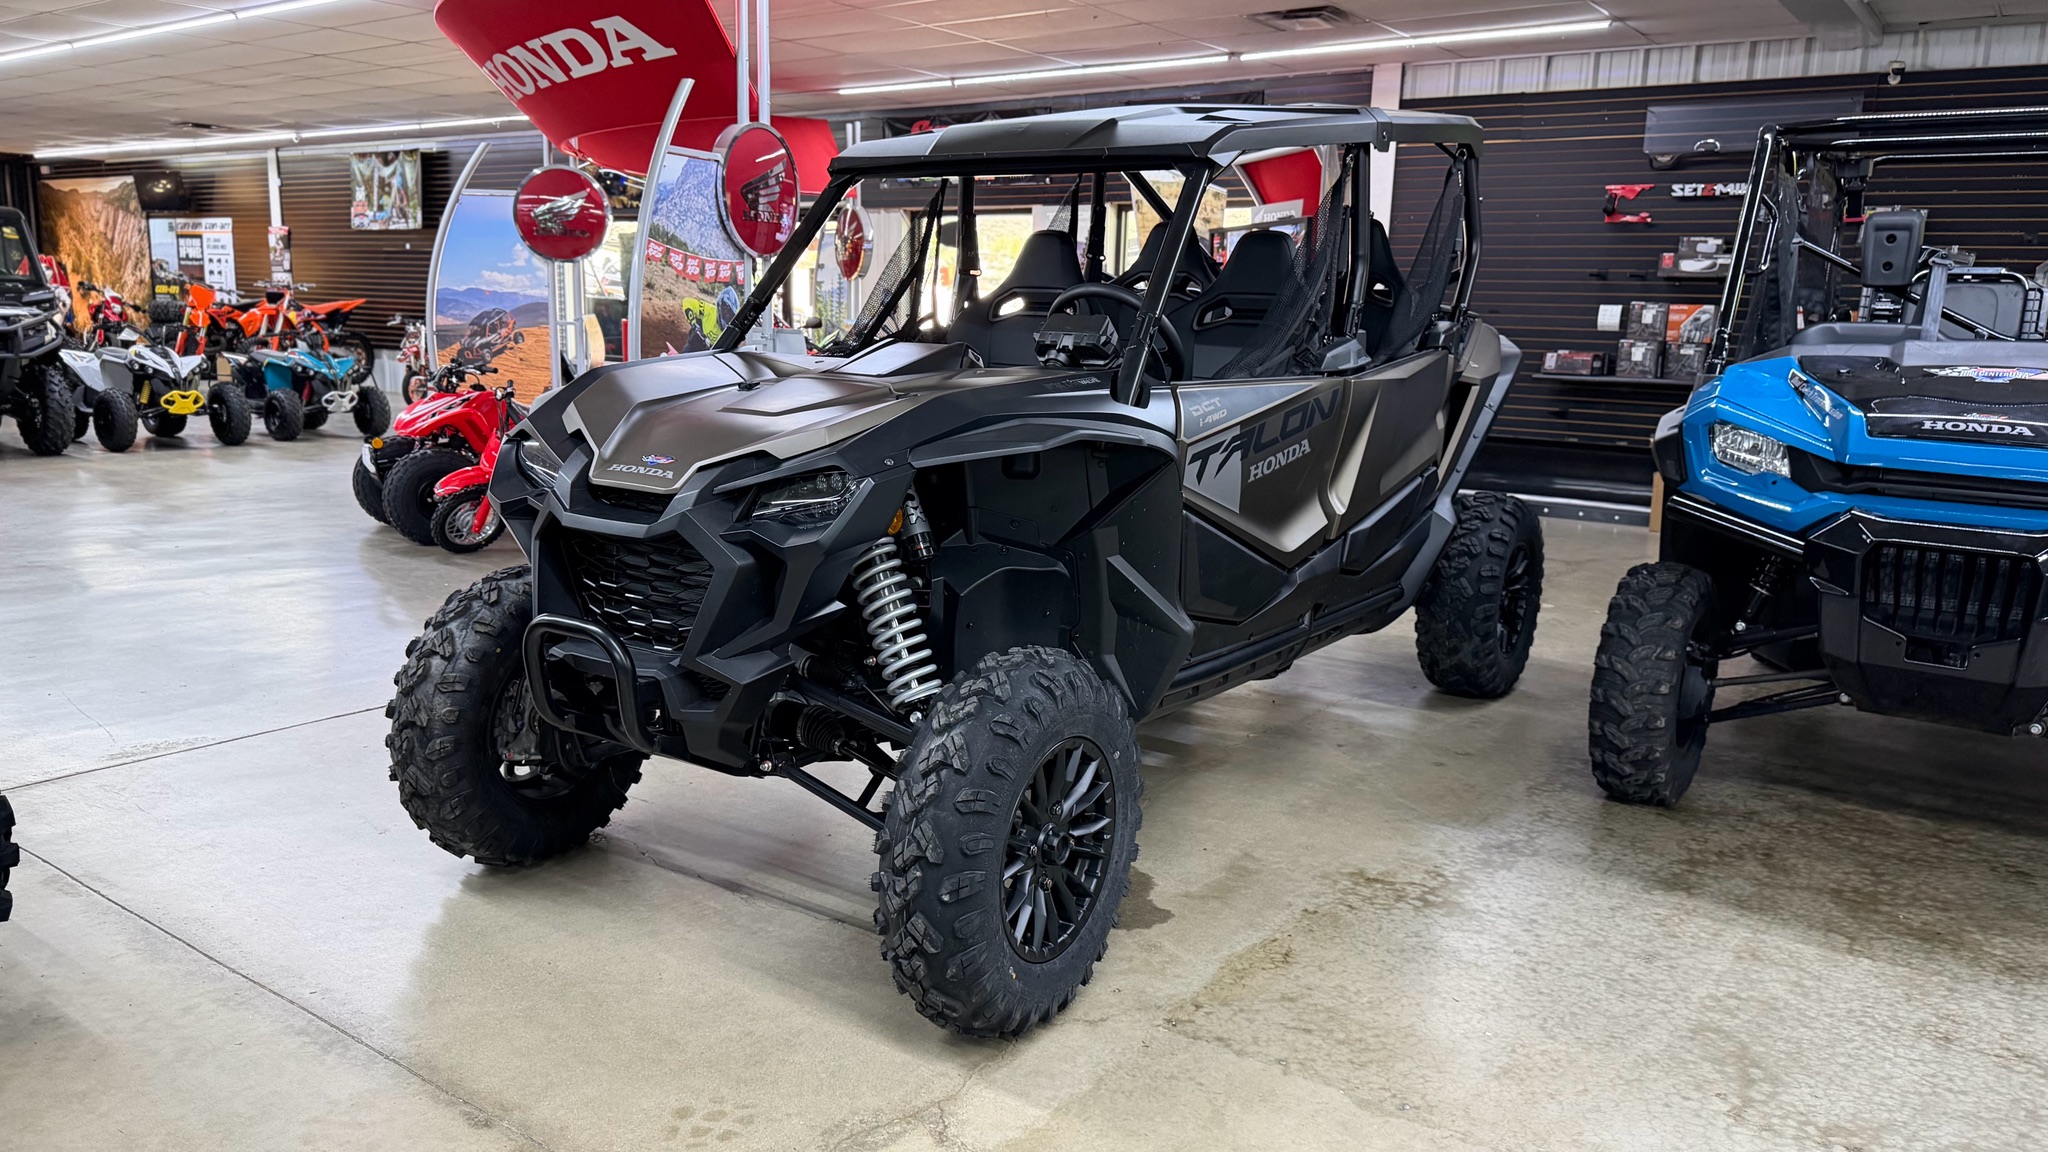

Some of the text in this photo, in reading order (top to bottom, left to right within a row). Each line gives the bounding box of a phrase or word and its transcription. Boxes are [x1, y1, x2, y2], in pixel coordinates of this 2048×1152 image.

[482, 15, 678, 101] HONDA
[1189, 397, 1222, 417] DCT
[1187, 387, 1340, 486] TALON
[1921, 420, 2035, 436] HONDA
[607, 463, 674, 479] HONDA
[1248, 438, 1311, 483] HONDA
